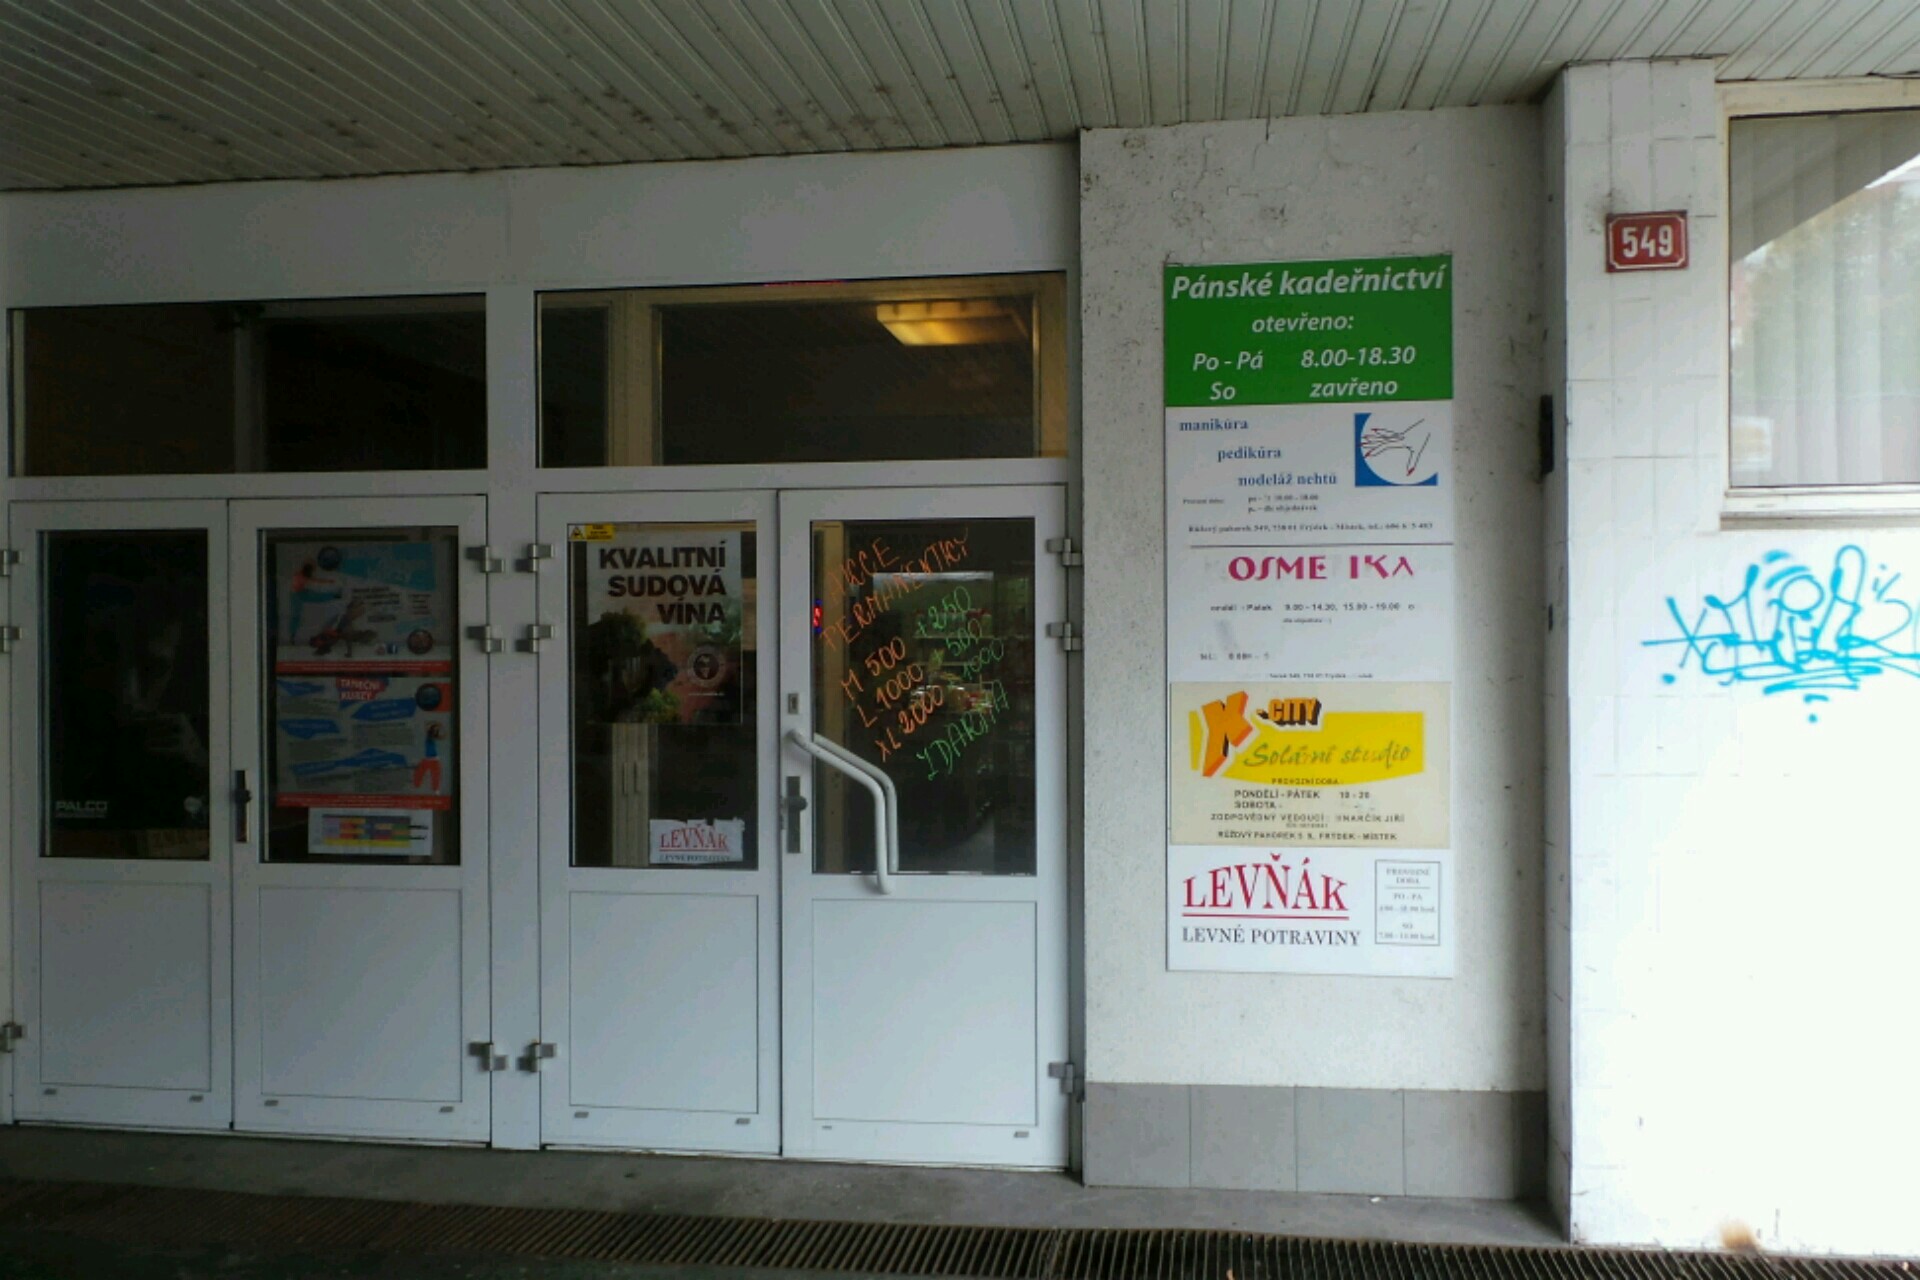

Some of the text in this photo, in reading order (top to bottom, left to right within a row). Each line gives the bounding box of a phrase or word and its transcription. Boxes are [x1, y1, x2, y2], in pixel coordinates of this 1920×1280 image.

[1622, 225, 1674, 259] 549
[1171, 264, 1448, 299] Pánské kadeřnictví
[1252, 313, 1354, 333] otevřeno:
[1192, 352, 1219, 371] Po
[1236, 349, 1265, 371] Pá
[1300, 345, 1416, 368] 8.00-18.30
[1209, 377, 1398, 400] So zavřeno
[600, 540, 727, 570] KVALITNÍ
[607, 567, 727, 598] SUDOVÁ
[656, 599, 726, 626] VÍNA
[865, 636, 906, 677] 500
[856, 702, 878, 728] L
[876, 663, 924, 709] 1000
[899, 685, 943, 735] 2000
[55, 800, 108, 811] PALCO
[660, 823, 729, 849] LEVŇÁK
[1183, 853, 1349, 911] LEVŇÁK
[1182, 924, 1362, 946] LEVNÉ POTRAVINY
